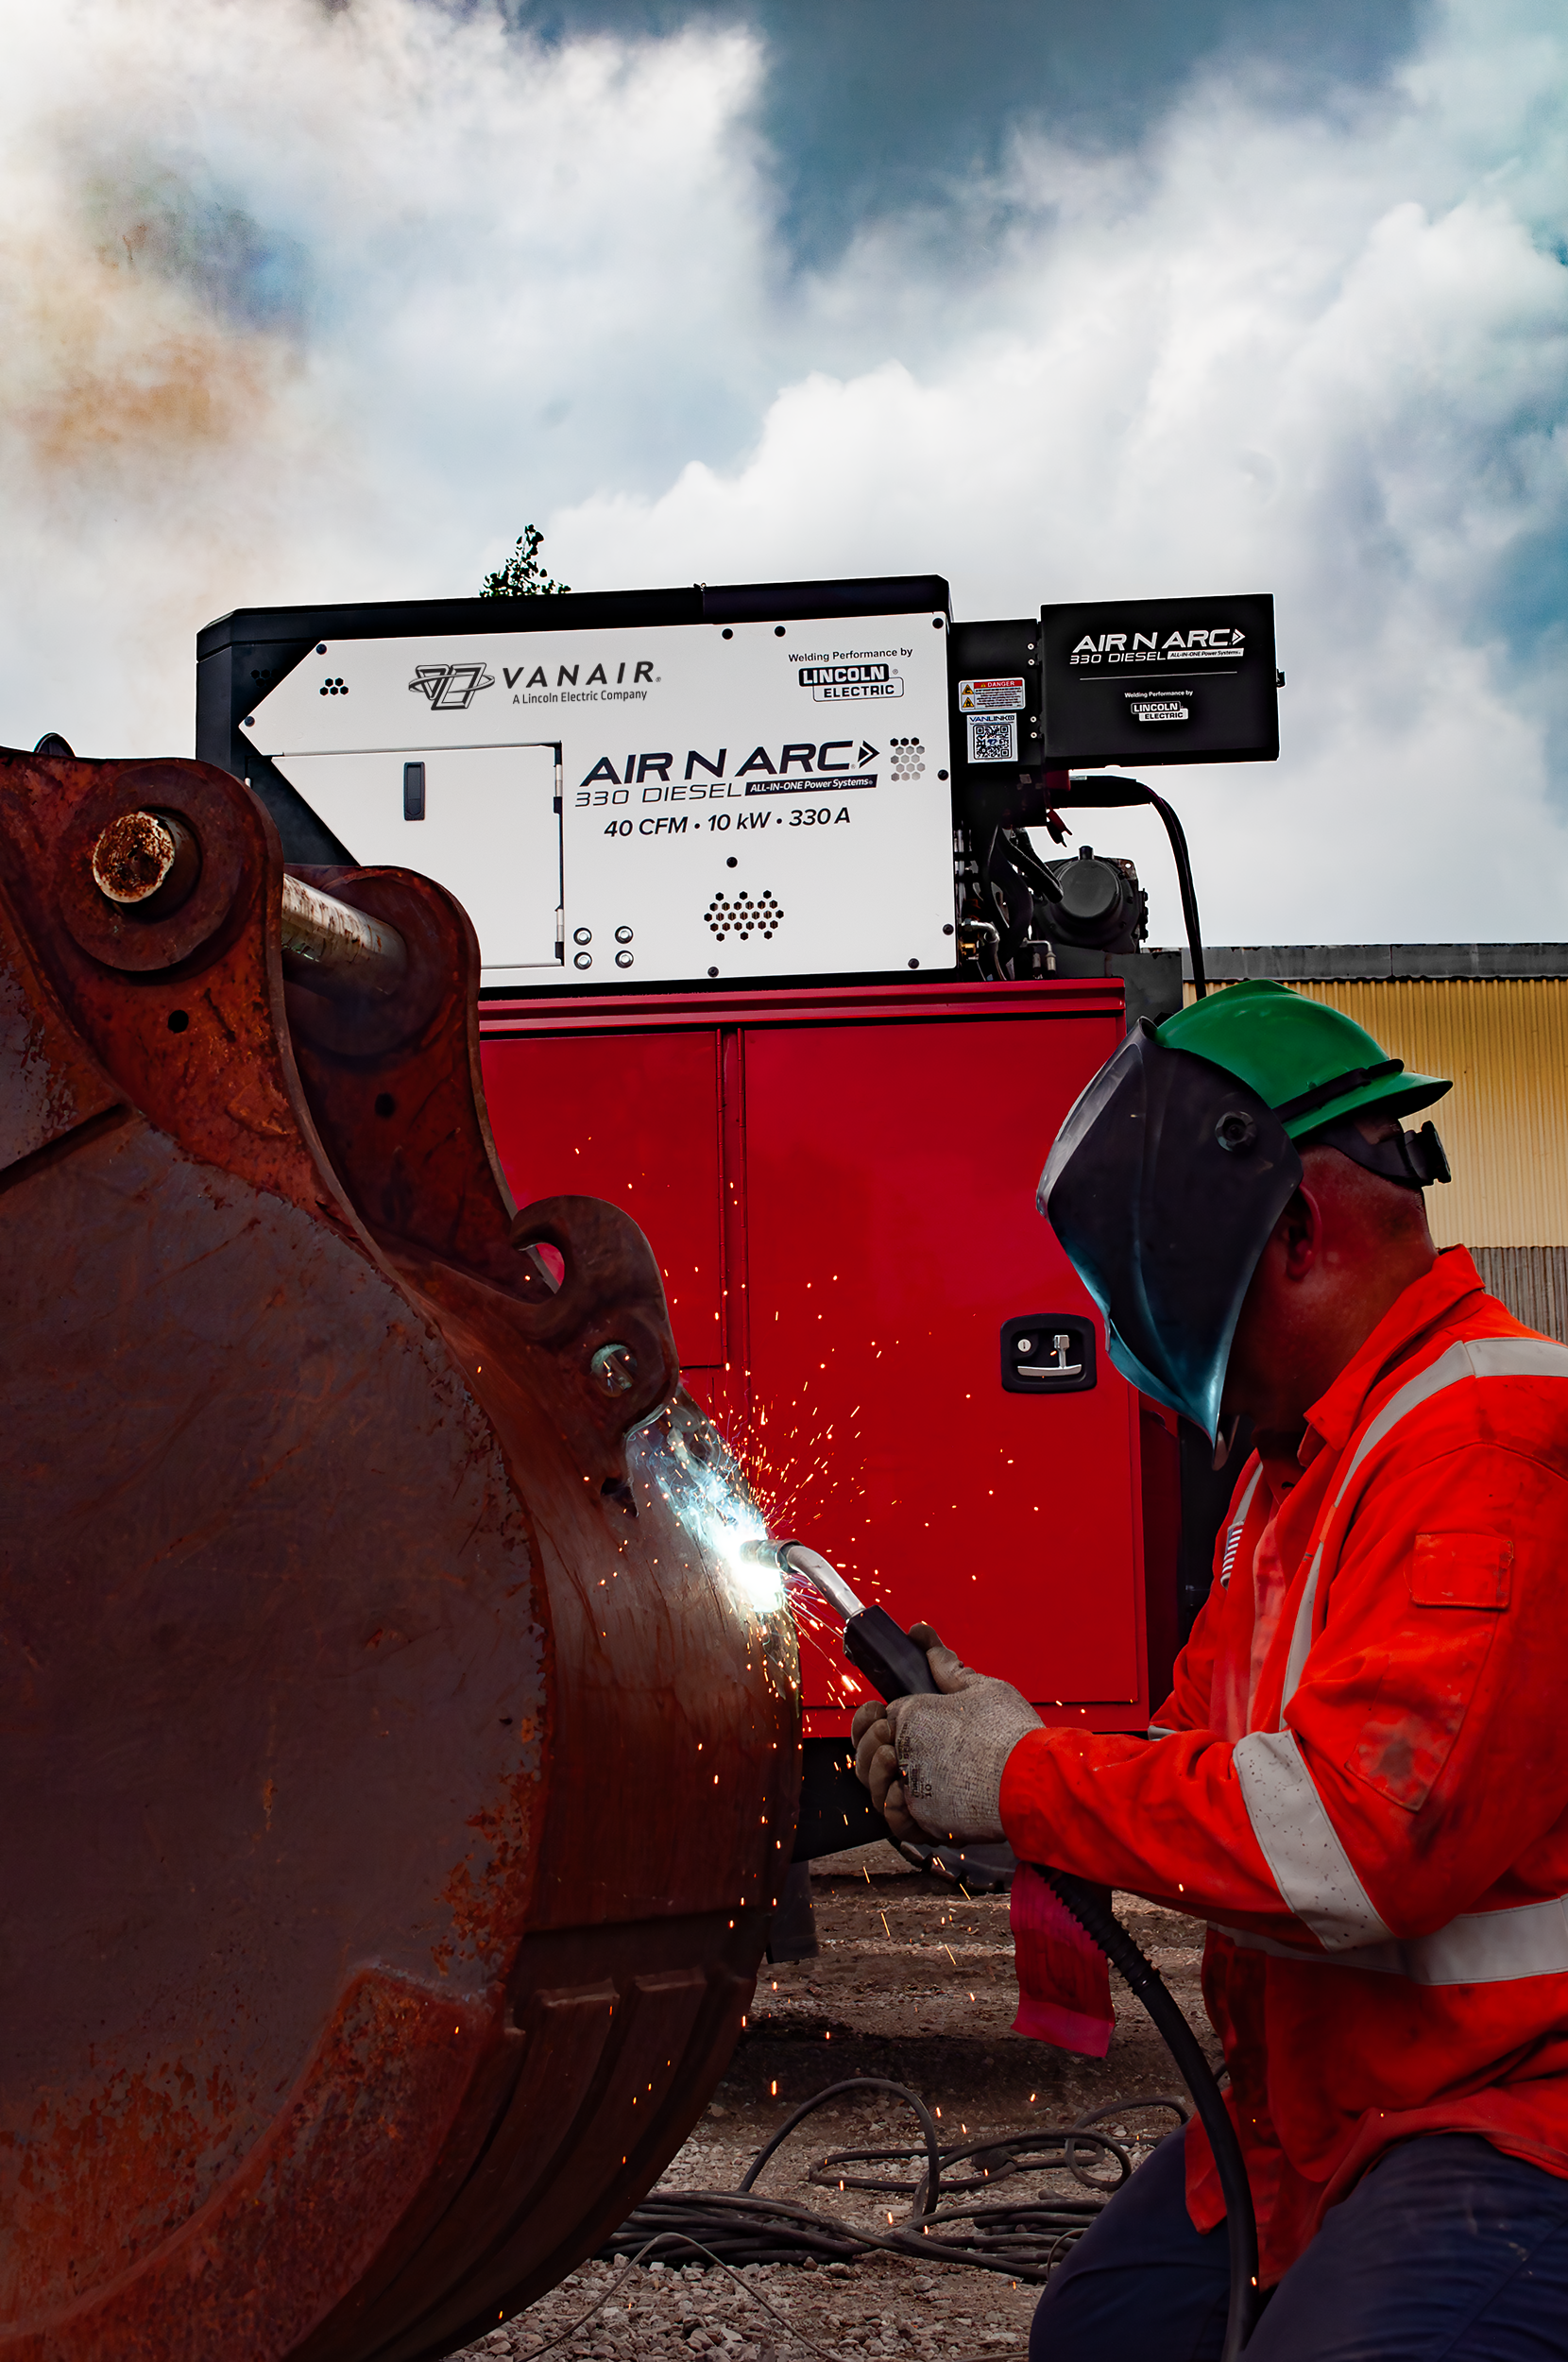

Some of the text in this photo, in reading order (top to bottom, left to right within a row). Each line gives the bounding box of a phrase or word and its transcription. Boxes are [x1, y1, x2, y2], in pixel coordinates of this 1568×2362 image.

[1072, 634, 1127, 653] AIR
[1133, 632, 1158, 651] N
[789, 647, 913, 662] Welding Performance by
[1069, 651, 1166, 665] 330 DIESEL
[512, 690, 648, 705] A Lincoln Electric Company
[824, 684, 895, 698] ELECTRIC
[1133, 702, 1178, 712] LINCOLN
[1145, 711, 1184, 720] ELECTRIC
[579, 752, 673, 787] AIR
[684, 748, 727, 780] N
[750, 780, 803, 793] ALL-IN-ONE
[804, 779, 831, 790] Power
[575, 782, 742, 808] 330 DIESEL
[604, 807, 851, 837] 40 CFM 10 kW 330 A
